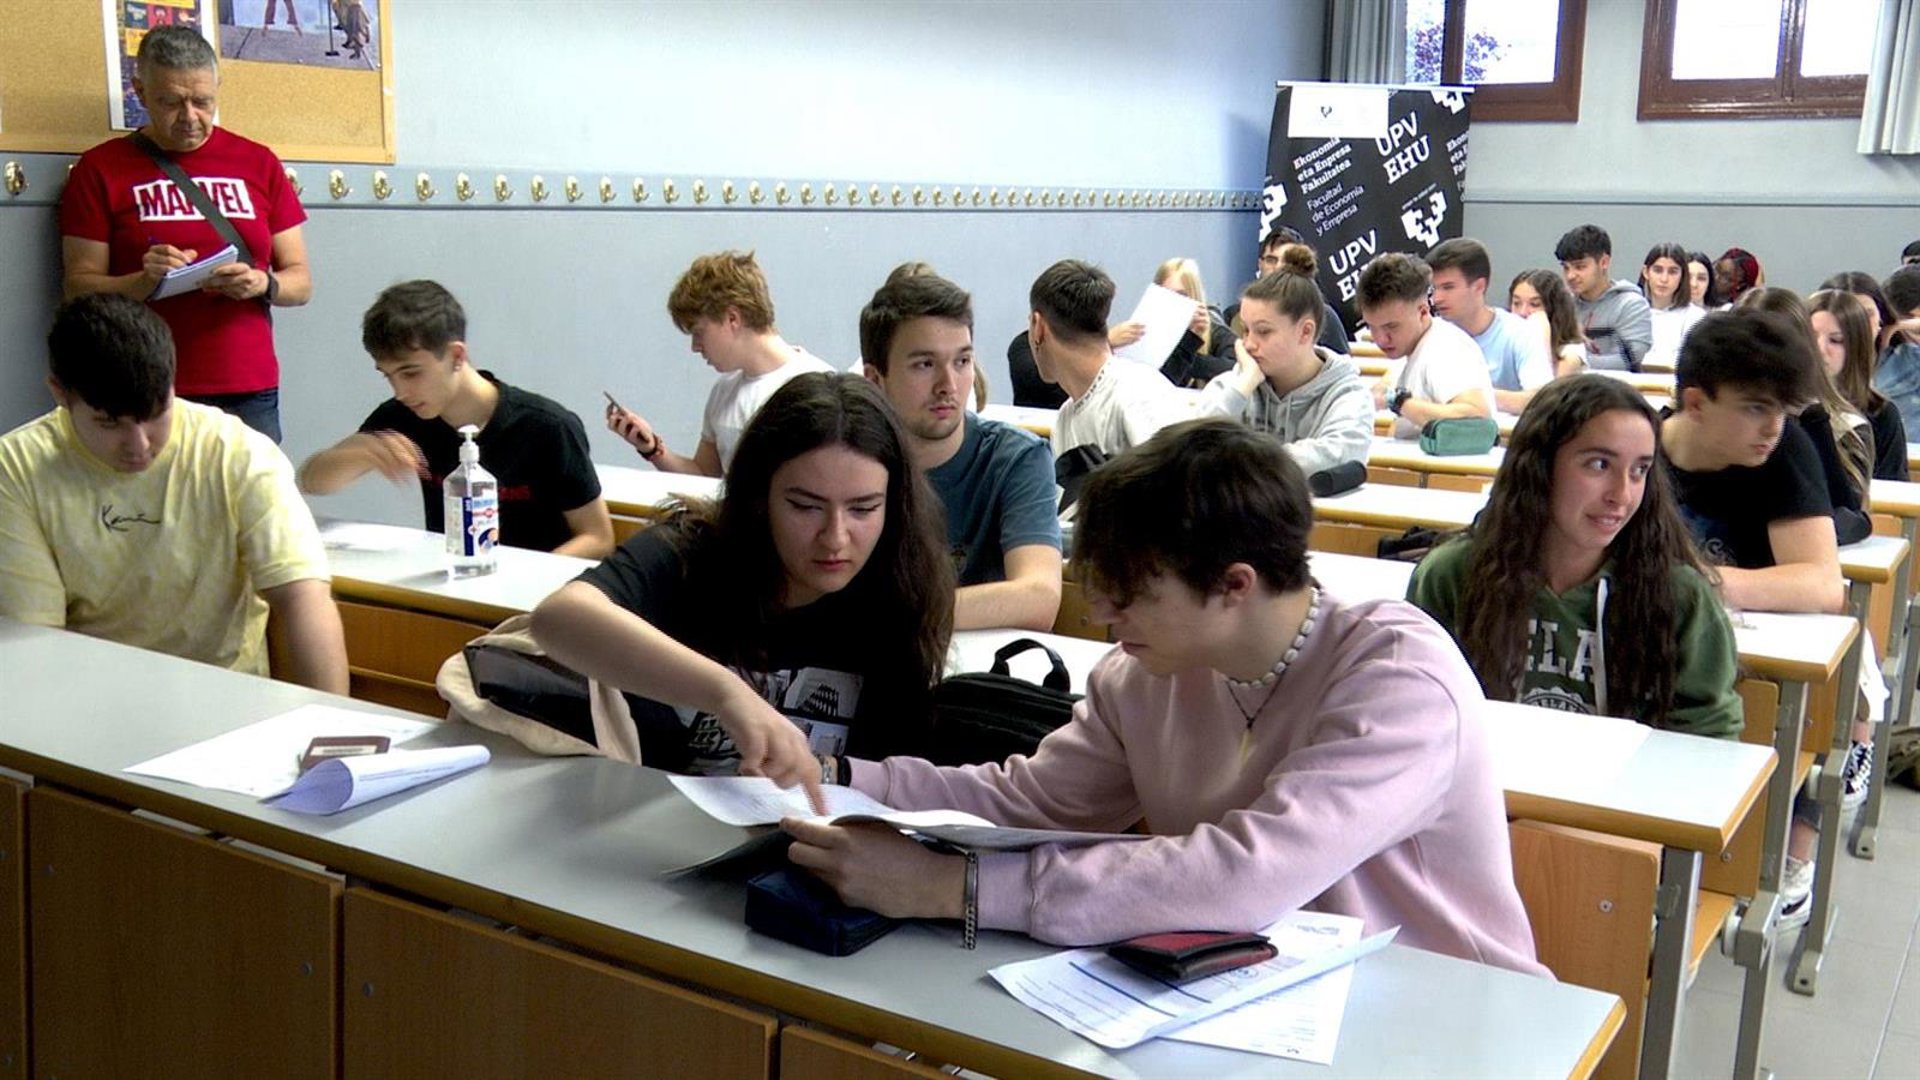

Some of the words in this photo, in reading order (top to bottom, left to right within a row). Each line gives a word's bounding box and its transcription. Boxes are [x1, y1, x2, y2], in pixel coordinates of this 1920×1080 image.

[1375, 111, 1418, 156] UPV
[1297, 166, 1315, 182] eta
[1313, 143, 1352, 173] Enpresa
[1300, 158, 1352, 195] Fakultatea
[1382, 134, 1430, 184] EHU
[138, 180, 251, 217] MAVEL
[1306, 181, 1343, 211] Facultad
[1311, 210, 1325, 223] de
[1315, 226, 1324, 237] y
[1321, 203, 1359, 232] Empresa
[1328, 228, 1377, 275] UPV
